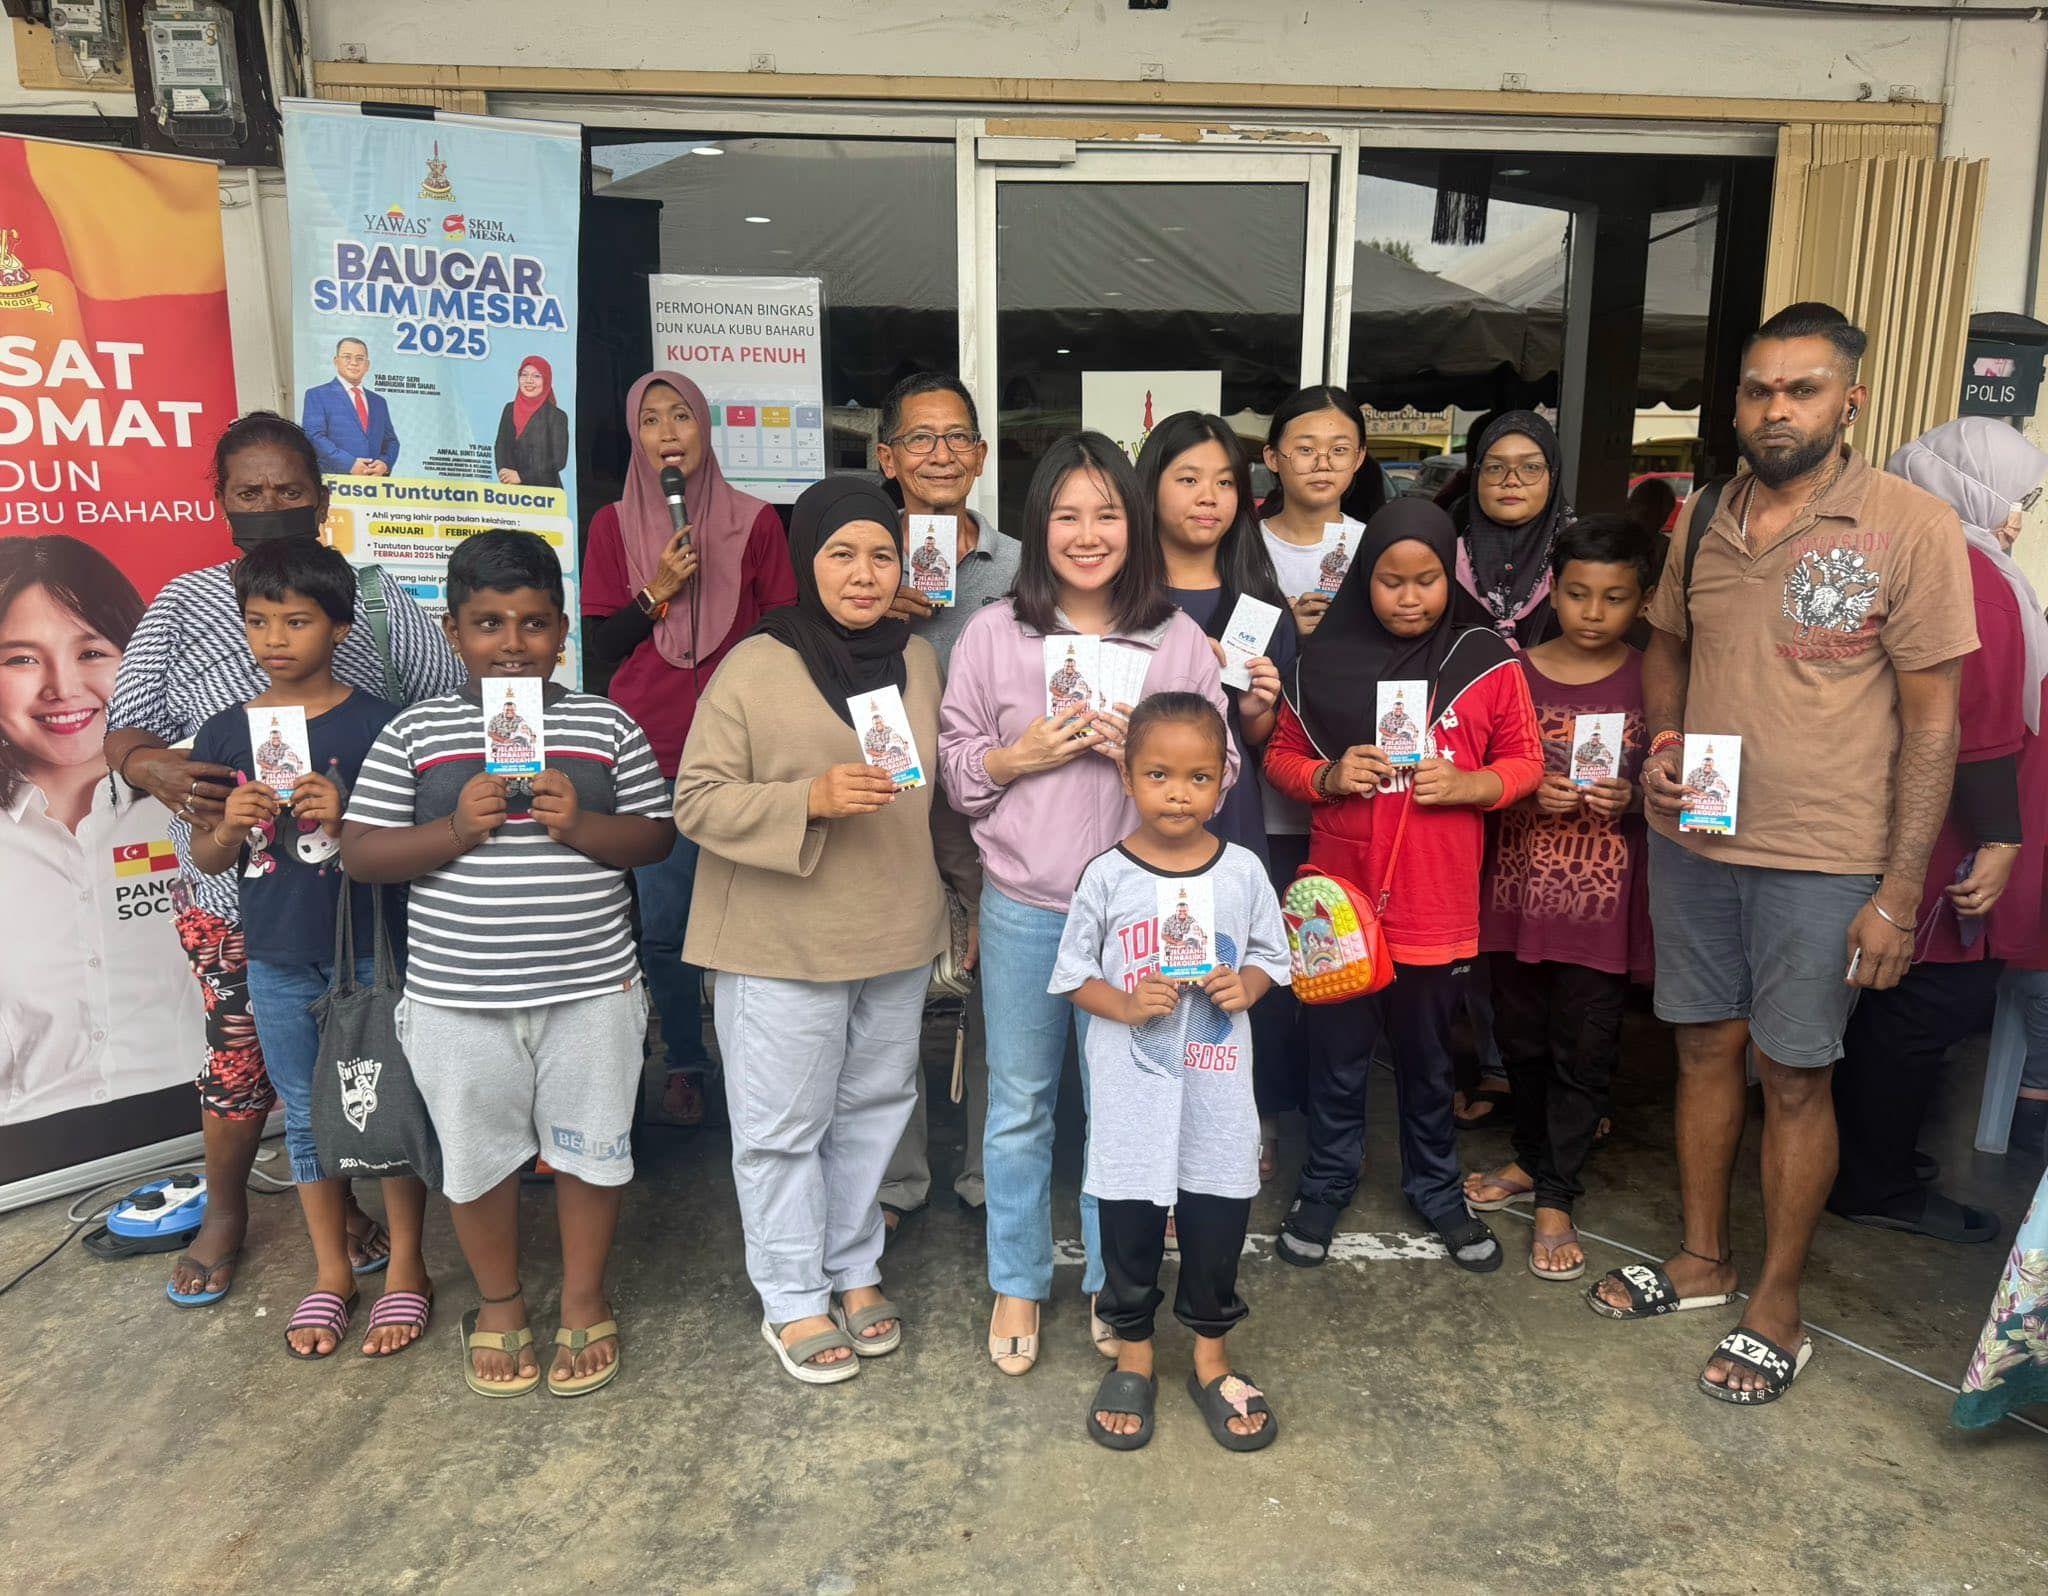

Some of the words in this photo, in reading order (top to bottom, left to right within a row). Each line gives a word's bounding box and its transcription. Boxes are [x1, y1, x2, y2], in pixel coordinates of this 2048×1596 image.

[364, 213, 428, 235] YAWAS
[468, 218, 503, 231] SKIM
[469, 229, 515, 243] MESRA
[336, 243, 543, 297] BAUCAR
[313, 279, 418, 316] SKIM
[428, 288, 565, 328] MESRA
[656, 302, 753, 316] PERMOHONAN
[757, 304, 814, 317] BINGKAS
[656, 322, 683, 334] DUN
[687, 323, 726, 335] KUALA
[729, 324, 762, 336] KUBU
[765, 325, 815, 337] BAHARU
[396, 321, 487, 357] 2025
[667, 345, 735, 362] KUOTA
[740, 346, 806, 364] PENUH
[1966, 384, 2016, 402] POLIS
[0, 460, 101, 492] DUN
[327, 480, 377, 498] Fasa
[382, 483, 478, 502] Tuntutan
[484, 488, 556, 508] Baucar
[77, 500, 215, 524] BAHARU
[434, 515, 455, 523] pada
[482, 516, 516, 526] kelahiran
[378, 526, 424, 535] JANUARI
[445, 528, 487, 537] FEBRUA
[373, 542, 411, 550] Tuntutan
[413, 543, 443, 551] baucar
[374, 550, 413, 558] FEBRUARI
[414, 551, 434, 559] 2025
[395, 575, 417, 583] yang
[405, 588, 420, 596] RIL
[118, 898, 170, 920] SOC
